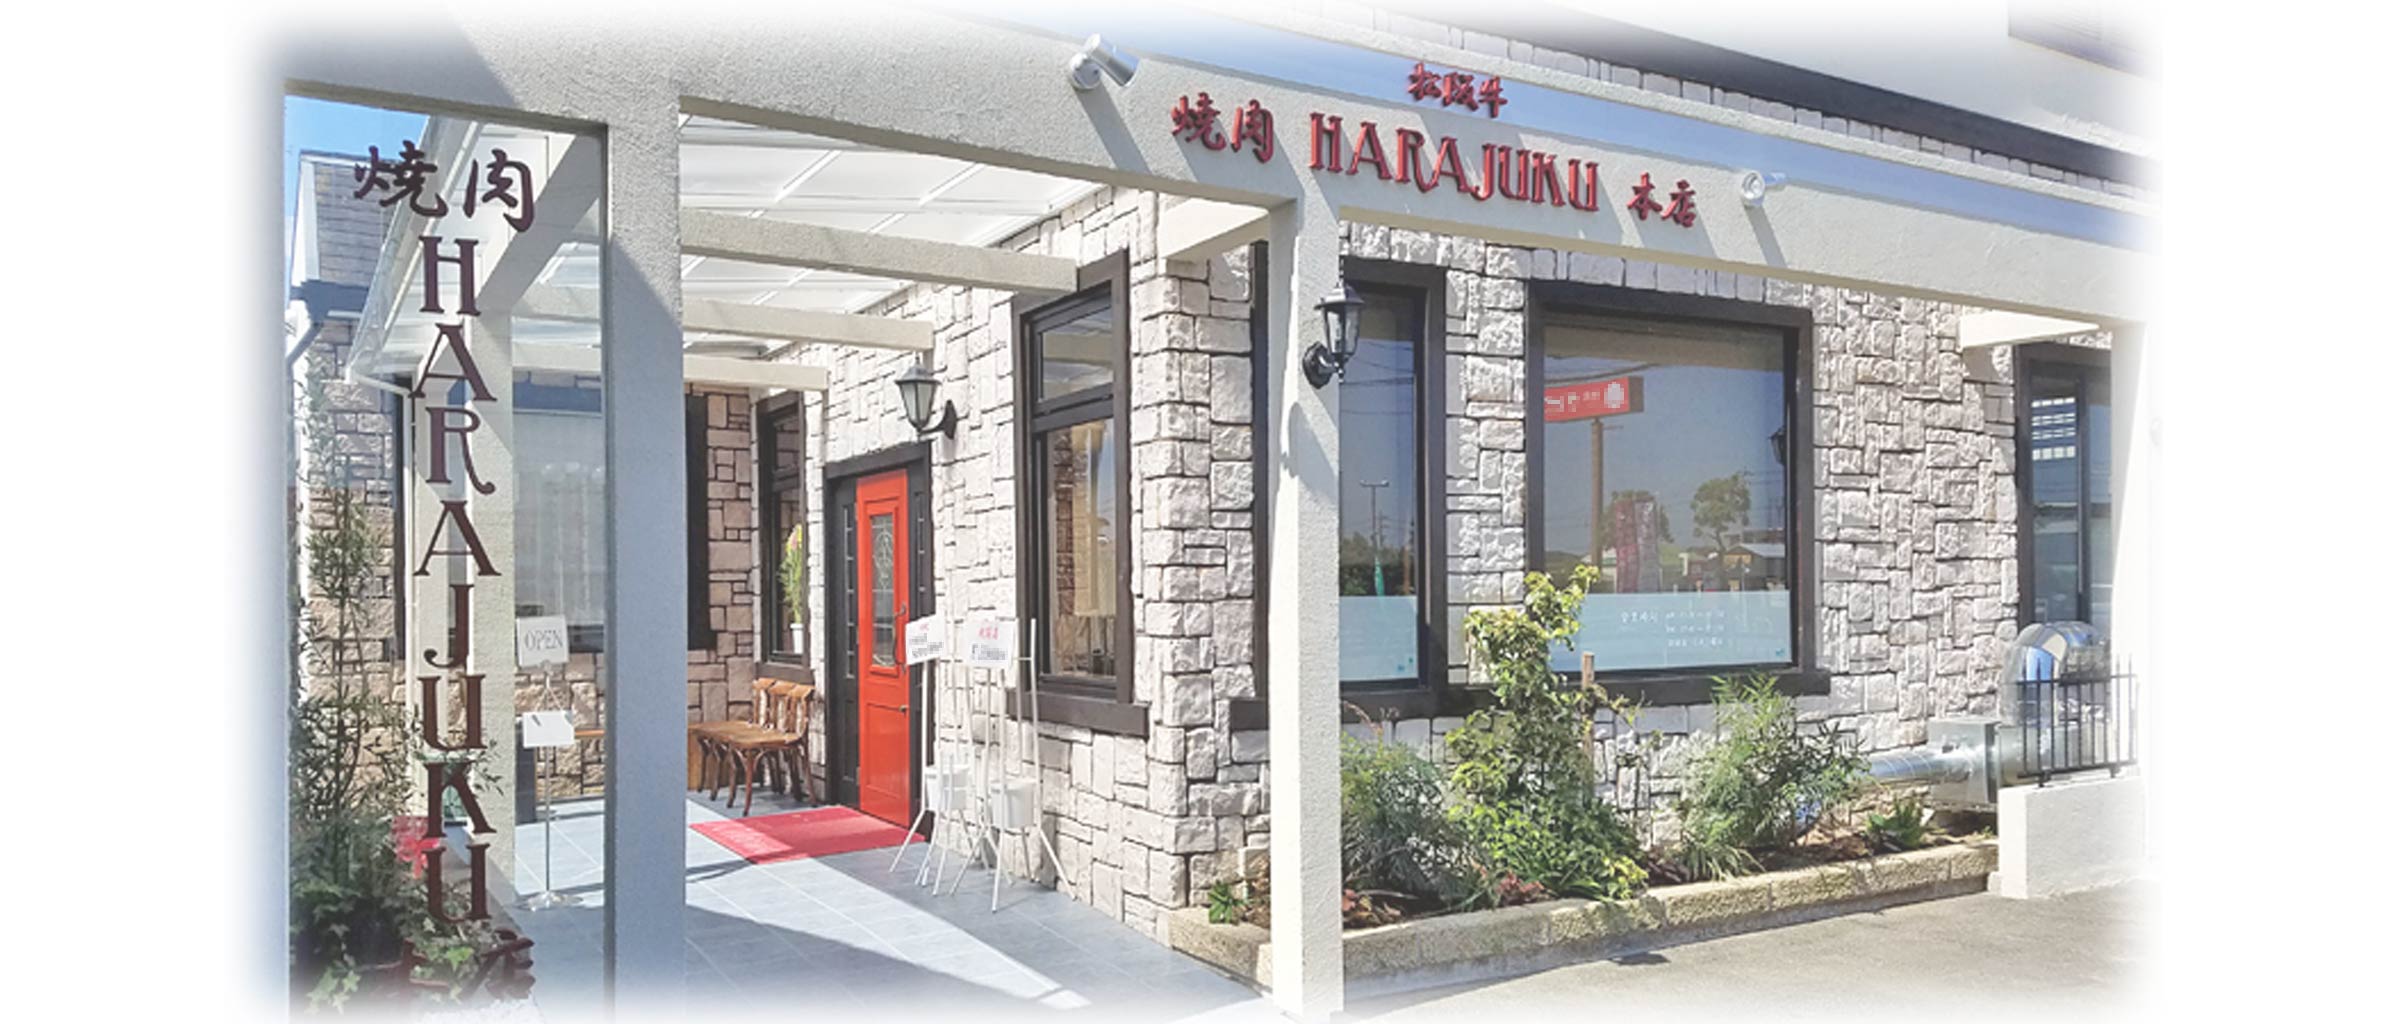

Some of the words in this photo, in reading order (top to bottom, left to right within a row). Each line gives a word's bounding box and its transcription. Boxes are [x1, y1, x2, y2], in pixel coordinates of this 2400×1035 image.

[1408, 62, 1508, 118] 松阪牛
[353, 140, 535, 233] 焼肉
[1170, 91, 1276, 165] 焼肉
[1308, 111, 1600, 212] HARAJUKU
[1626, 172, 1697, 229] 本店
[408, 235, 501, 923] HARAJUKU
[524, 628, 563, 652] OPEN
